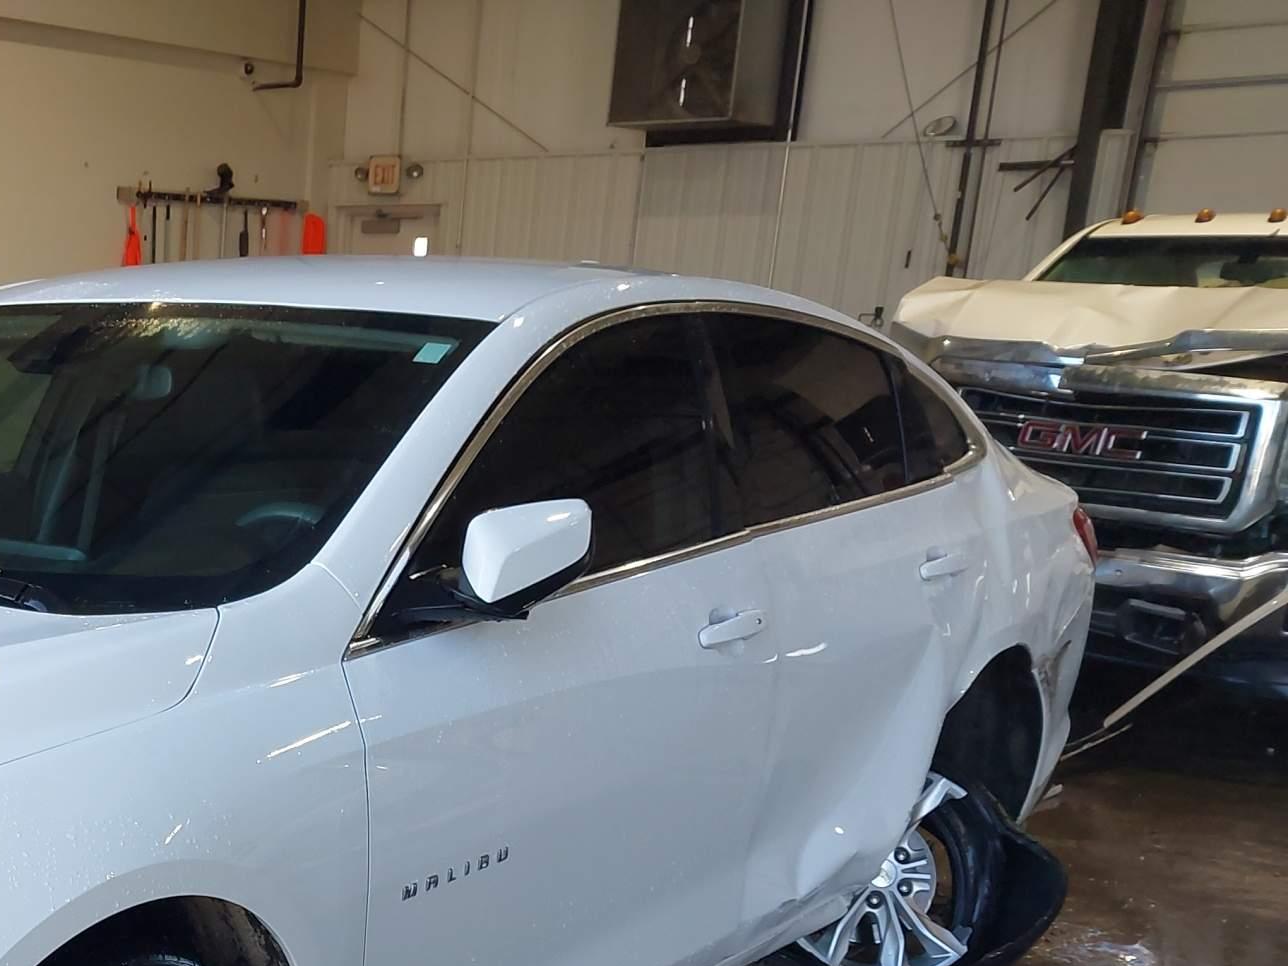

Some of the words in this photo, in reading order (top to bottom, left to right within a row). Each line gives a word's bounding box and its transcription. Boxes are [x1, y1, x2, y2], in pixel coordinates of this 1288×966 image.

[374, 164, 396, 185] EXIT
[1017, 420, 1148, 460] GMC
[402, 846, 509, 901] MALIBU
